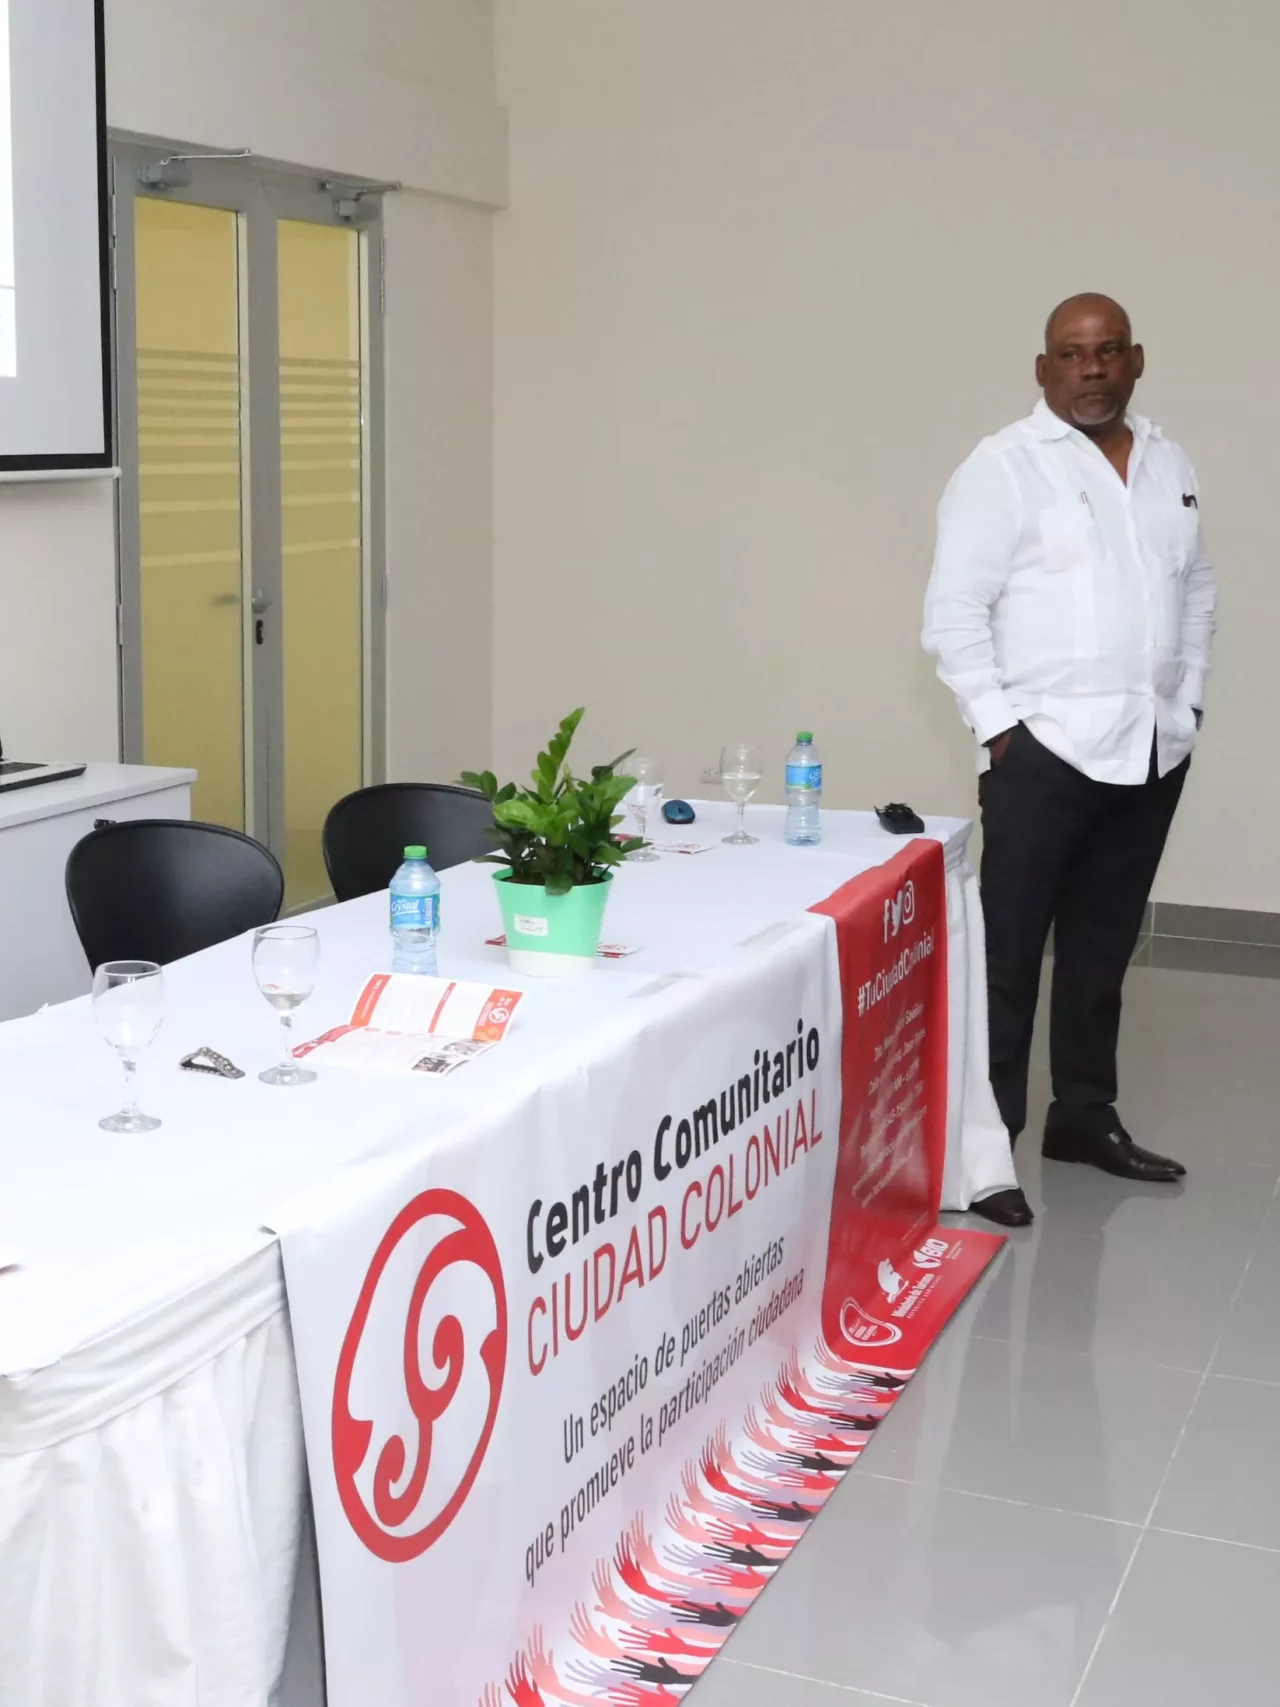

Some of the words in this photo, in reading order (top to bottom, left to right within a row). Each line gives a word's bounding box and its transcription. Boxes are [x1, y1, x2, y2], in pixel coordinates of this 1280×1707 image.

[857, 926, 935, 1017] #TuCiuadCnial
[526, 1149, 643, 1274] Centro
[653, 1018, 820, 1182] Comunitario
[527, 1204, 668, 1377] CIUDAD
[679, 1088, 823, 1250] COLONIAL
[525, 1521, 554, 1588] que
[560, 1435, 635, 1552] promueve
[639, 1413, 653, 1455] la
[658, 1325, 744, 1447] participación
[747, 1268, 804, 1347] ciudadana
[563, 1414, 584, 1464] Un
[590, 1353, 648, 1437] espacio
[654, 1332, 675, 1377] de
[680, 1284, 731, 1367] puertas
[734, 1236, 784, 1306] abiertas
